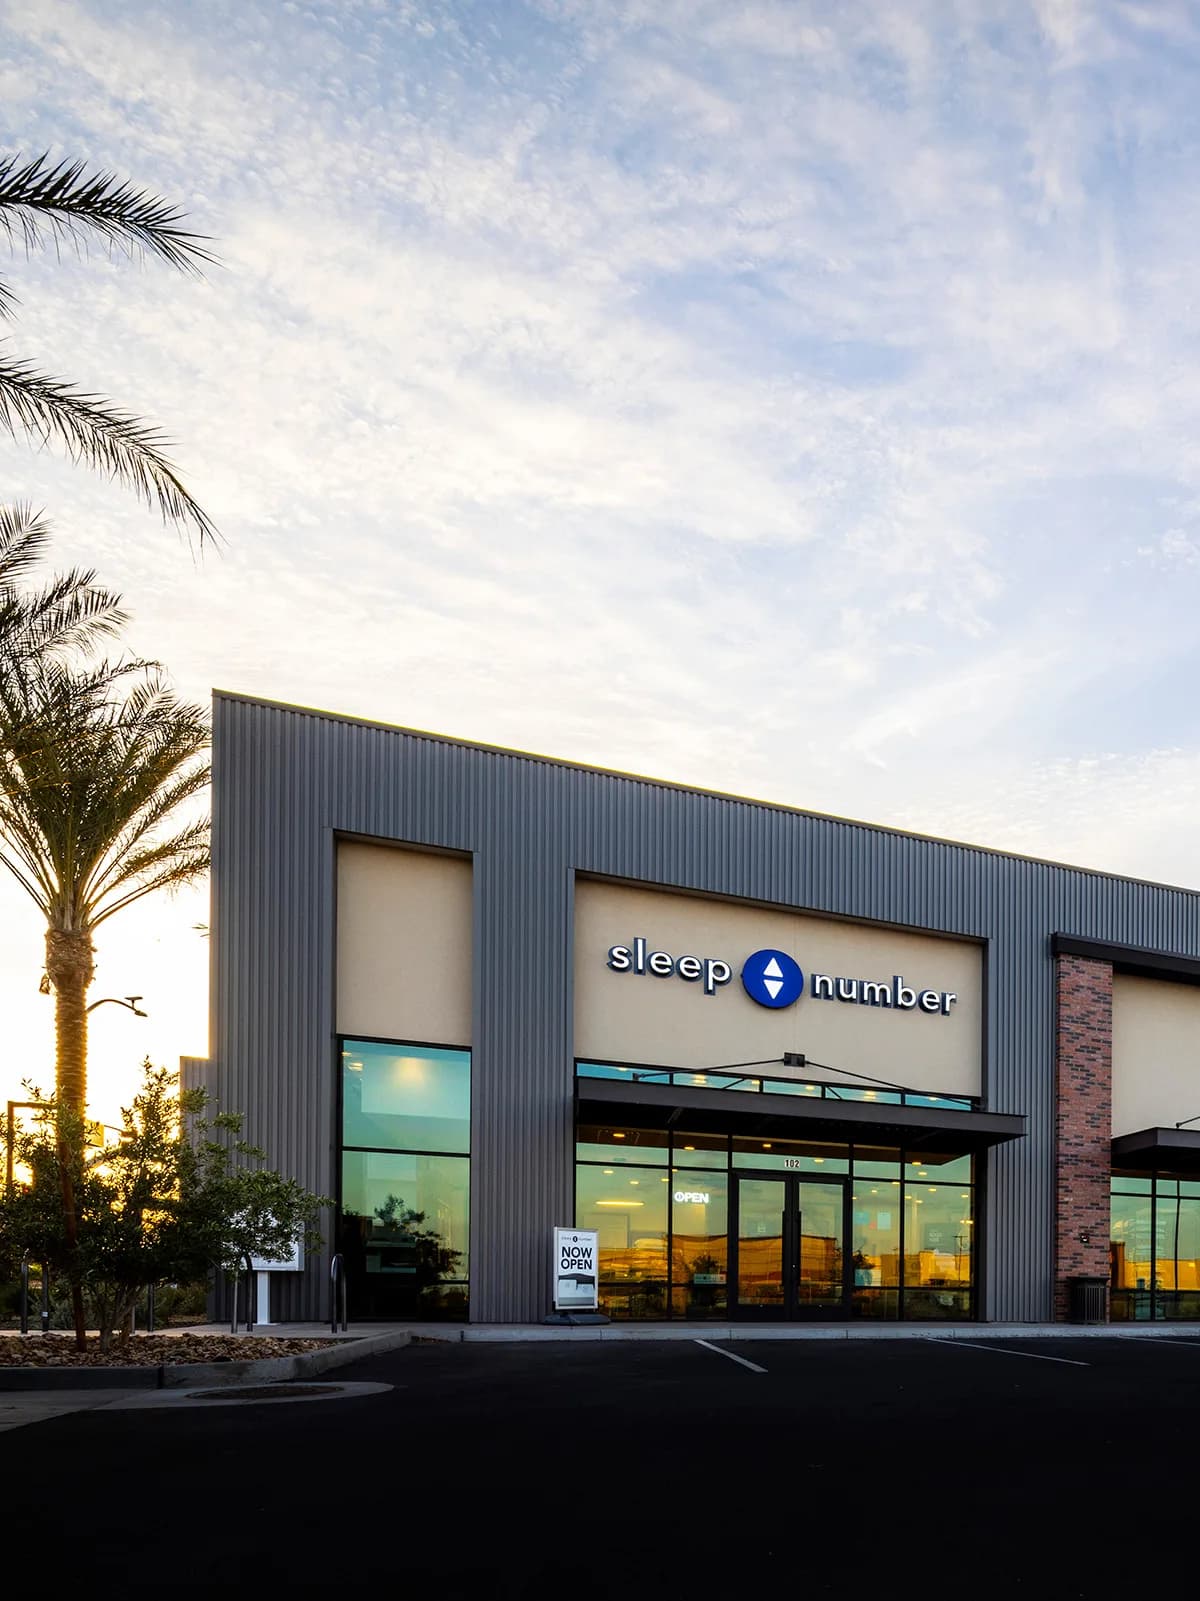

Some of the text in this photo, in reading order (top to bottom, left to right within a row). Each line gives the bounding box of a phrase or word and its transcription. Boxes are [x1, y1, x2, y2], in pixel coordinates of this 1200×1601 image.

[607, 937, 957, 1016] sleep number
[784, 1159, 800, 1168] 102
[674, 1191, 710, 1204] OPEN
[561, 1246, 593, 1259] NOW
[560, 1258, 593, 1270] OPEN
